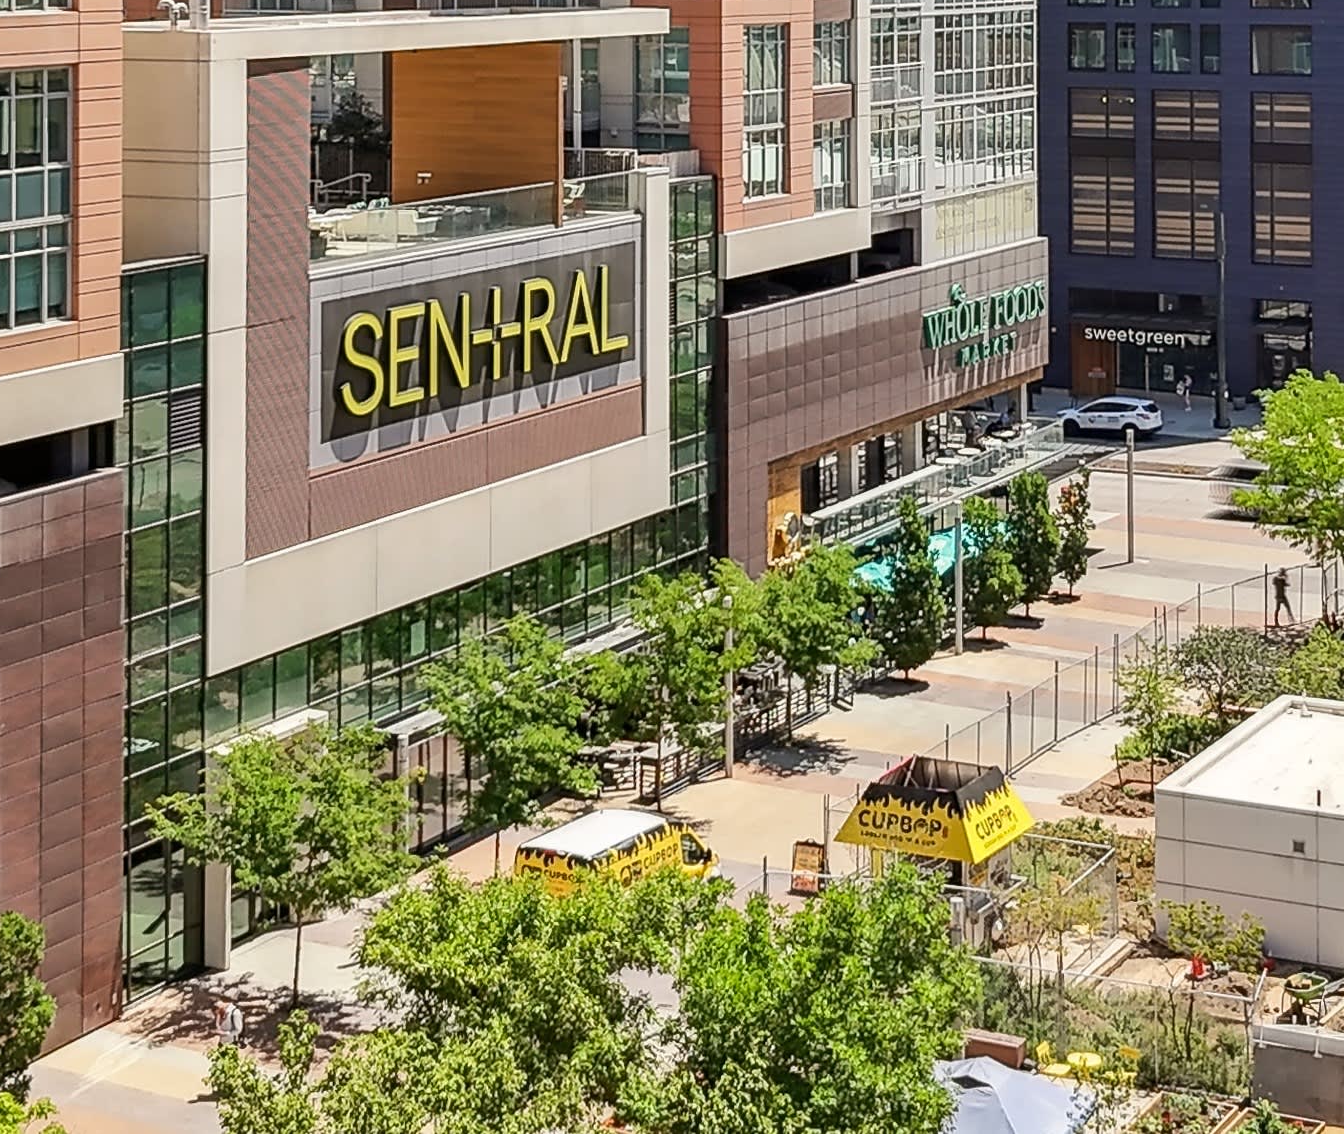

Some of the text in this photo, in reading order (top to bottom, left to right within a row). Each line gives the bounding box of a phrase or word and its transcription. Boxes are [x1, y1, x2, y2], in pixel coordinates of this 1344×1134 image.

[922, 279, 1046, 350] WHOLE FOODS
[958, 331, 1018, 369] MARKET
[1084, 327, 1185, 348] sweetgreen
[858, 809, 942, 836] CUPBOP
[643, 842, 680, 872] CUPBOP
